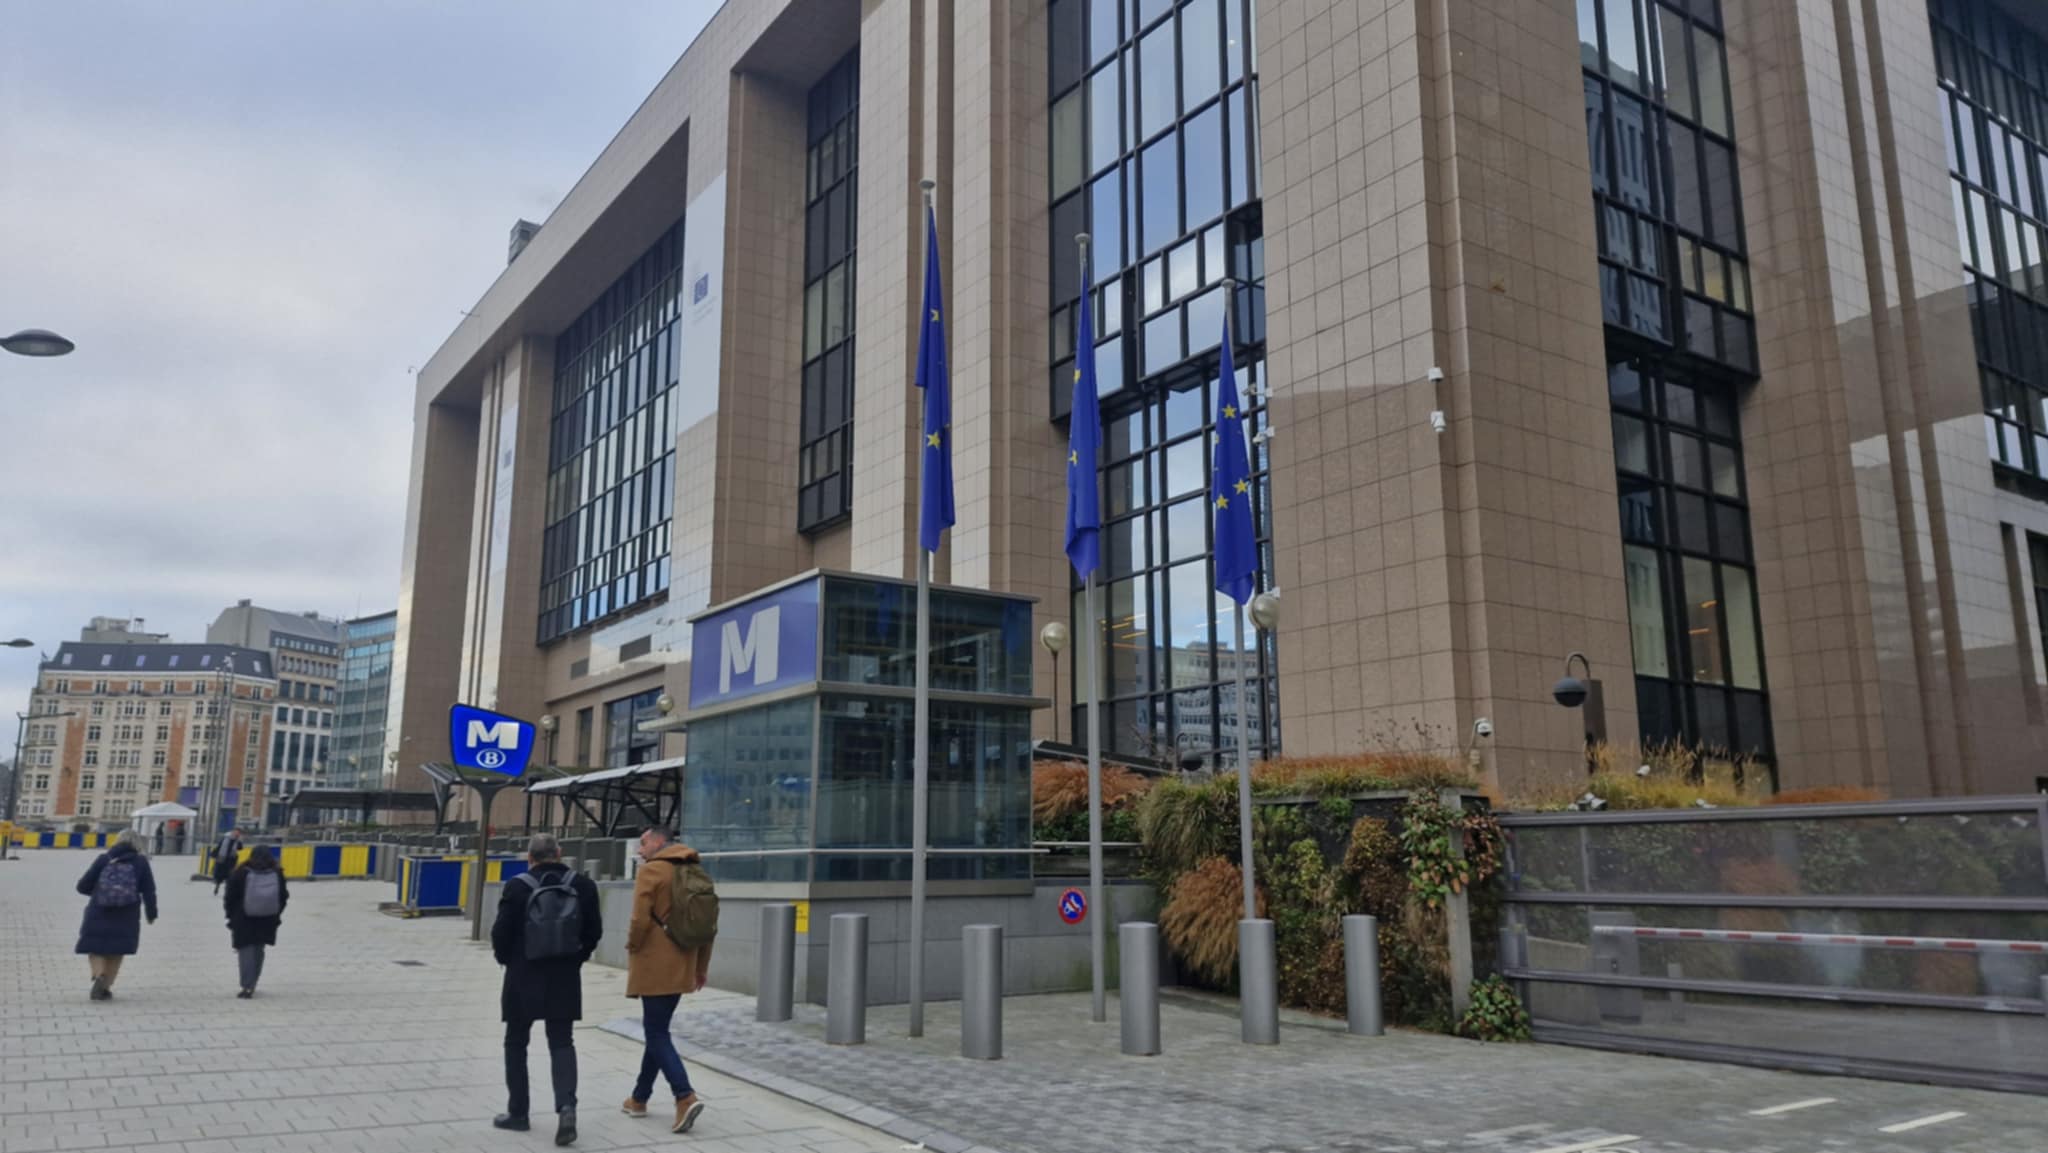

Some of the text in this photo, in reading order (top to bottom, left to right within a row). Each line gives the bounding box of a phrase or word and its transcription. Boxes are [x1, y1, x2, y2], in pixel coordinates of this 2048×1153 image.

[719, 605, 780, 694] M
[466, 720, 519, 749] M
[484, 751, 498, 765] B
